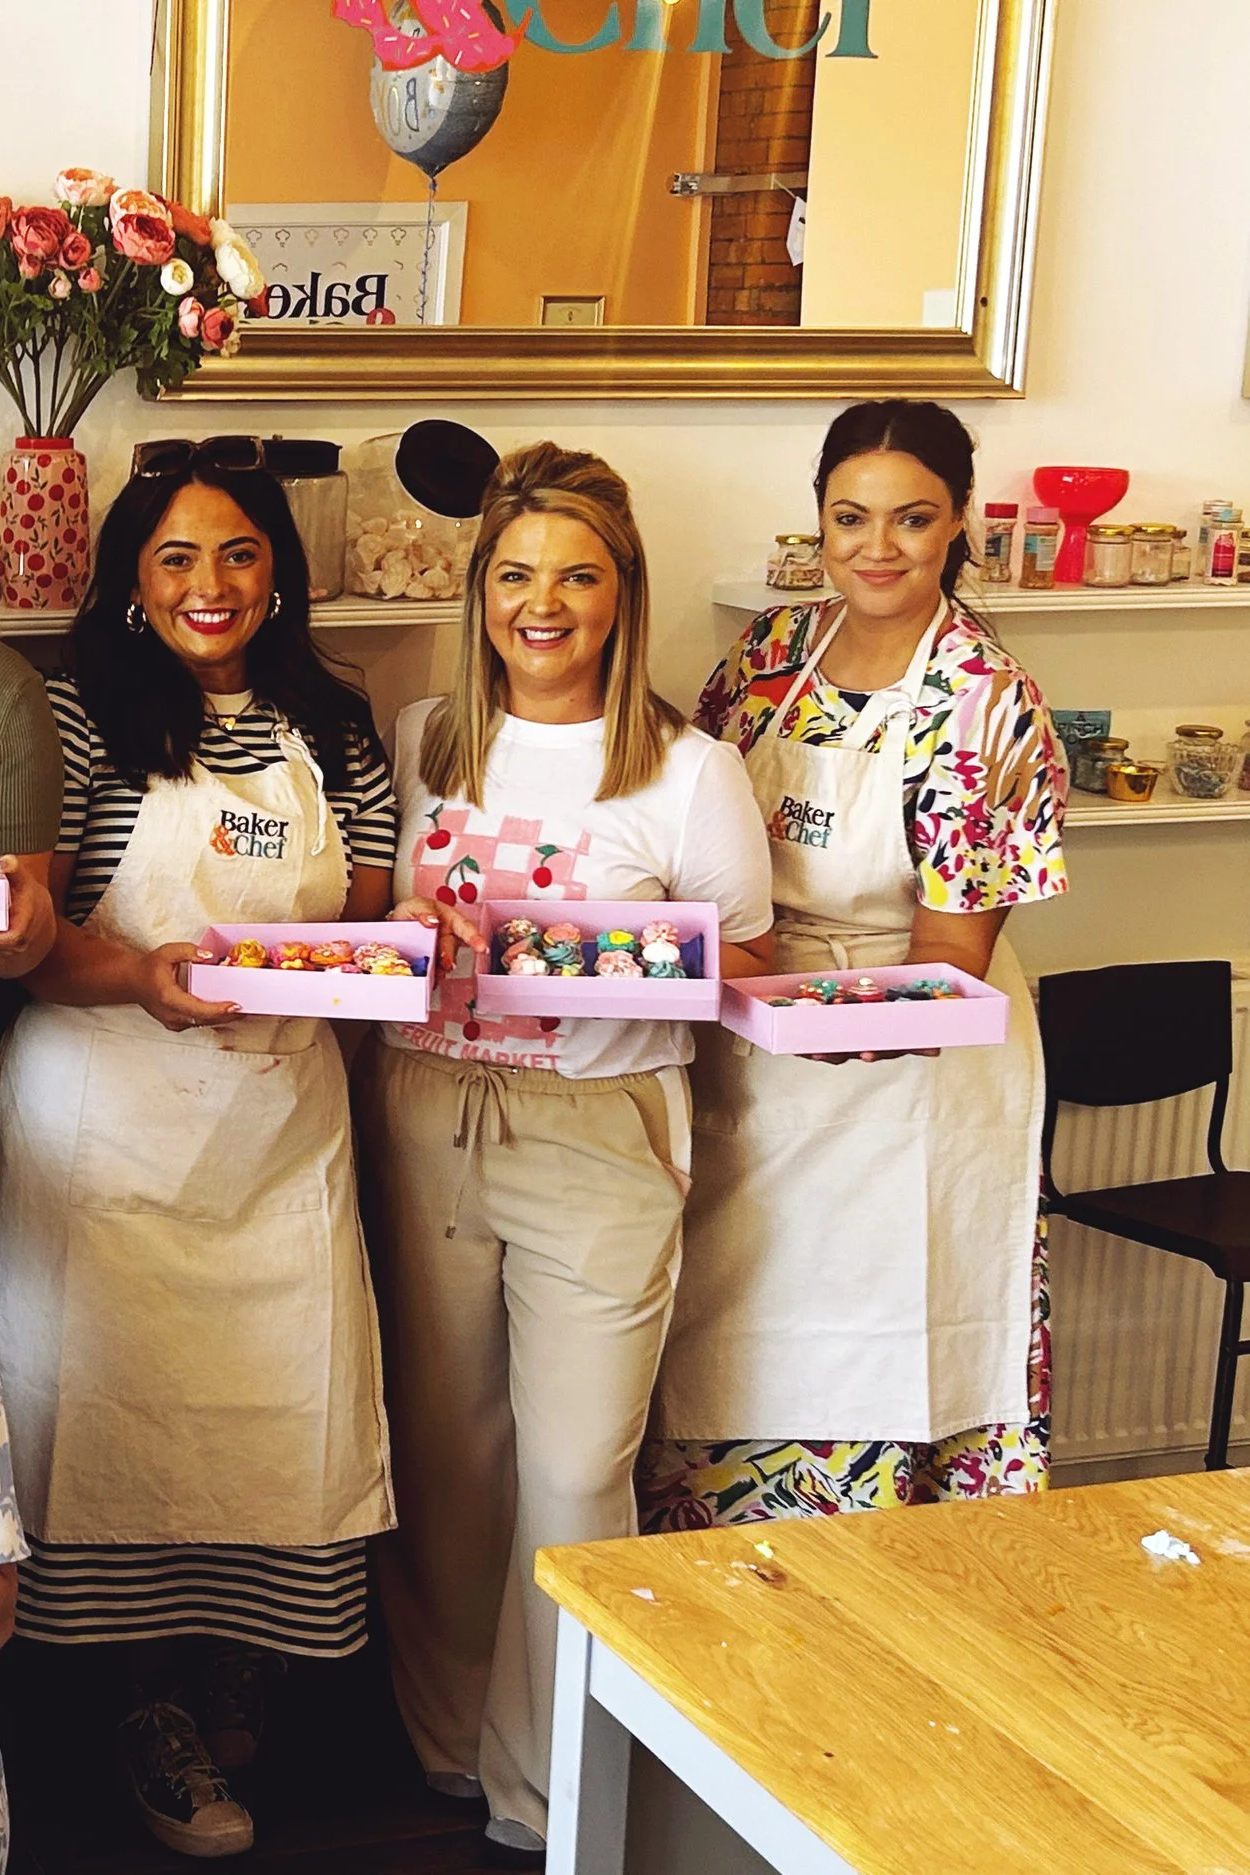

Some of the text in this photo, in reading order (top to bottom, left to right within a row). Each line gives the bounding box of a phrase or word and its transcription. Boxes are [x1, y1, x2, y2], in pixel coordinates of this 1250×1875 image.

[221, 810, 289, 838] Baker
[780, 796, 835, 828] Baker
[401, 1024, 561, 1069] FRUIT MARKET
